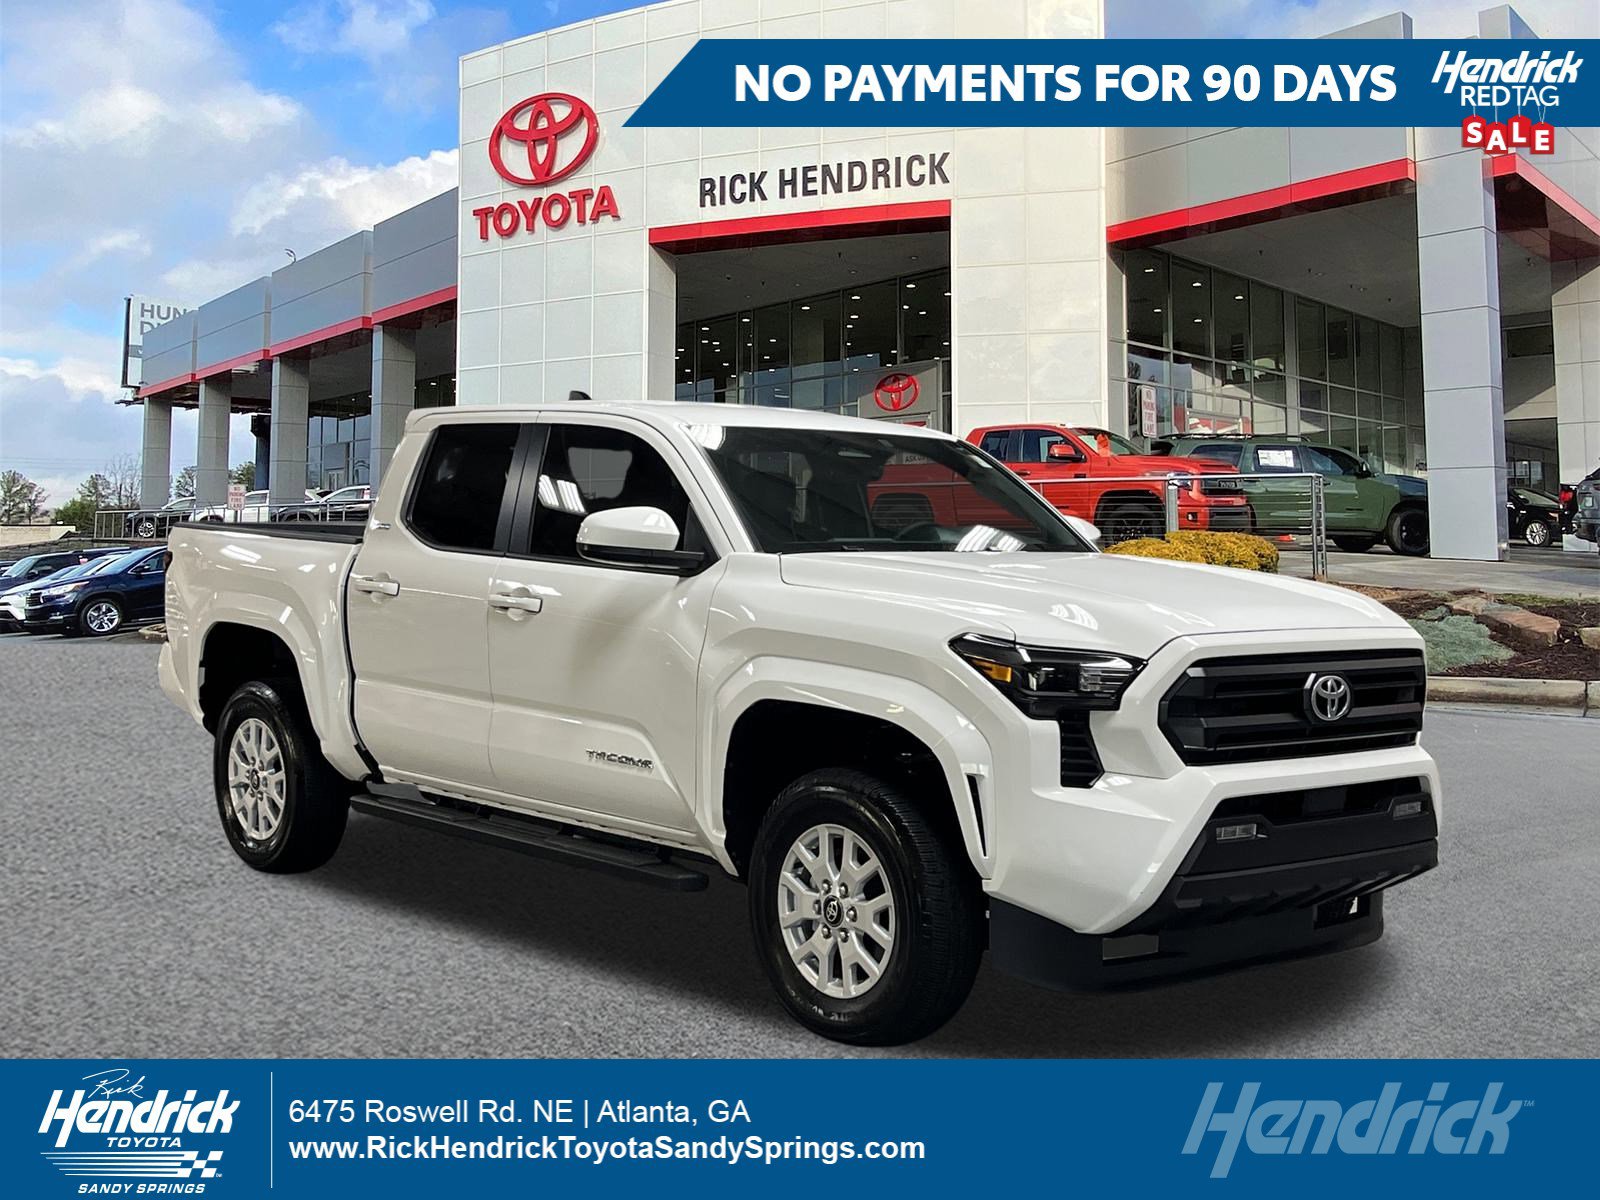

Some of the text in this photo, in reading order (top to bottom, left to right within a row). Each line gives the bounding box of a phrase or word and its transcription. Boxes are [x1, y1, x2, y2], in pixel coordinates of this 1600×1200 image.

[699, 152, 951, 208] RICK HENDRICK
[473, 185, 621, 241] TOYOTA
[585, 749, 654, 769] TACOMA
